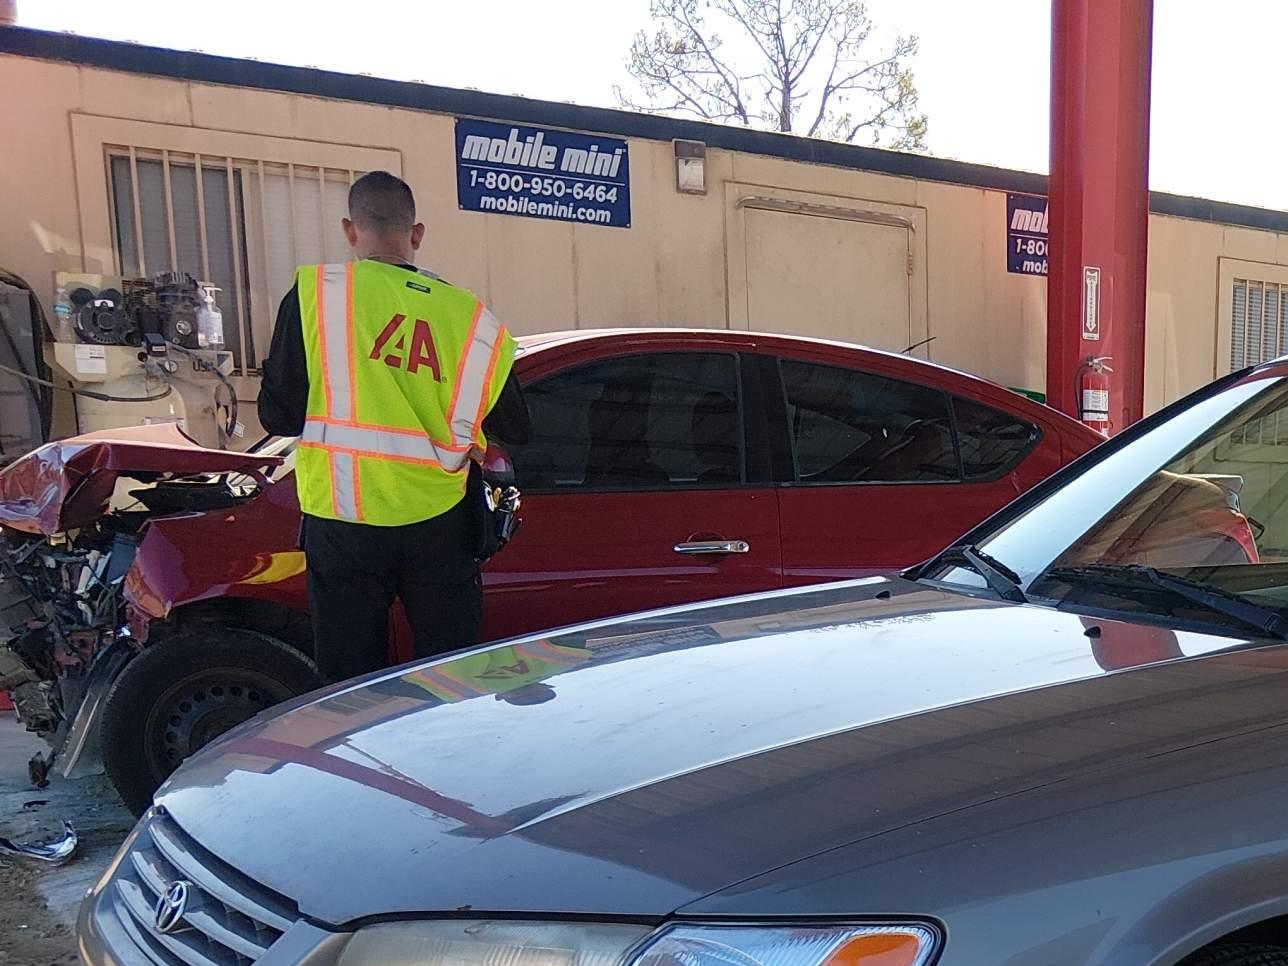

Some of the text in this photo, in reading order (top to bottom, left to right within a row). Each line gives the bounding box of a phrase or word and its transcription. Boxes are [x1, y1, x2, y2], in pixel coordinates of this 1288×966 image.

[461, 128, 622, 178] mobile mini
[469, 170, 618, 204] 1-800-950-6464
[480, 195, 611, 223] mobilemini.com
[1016, 238, 1048, 256] 1-80
